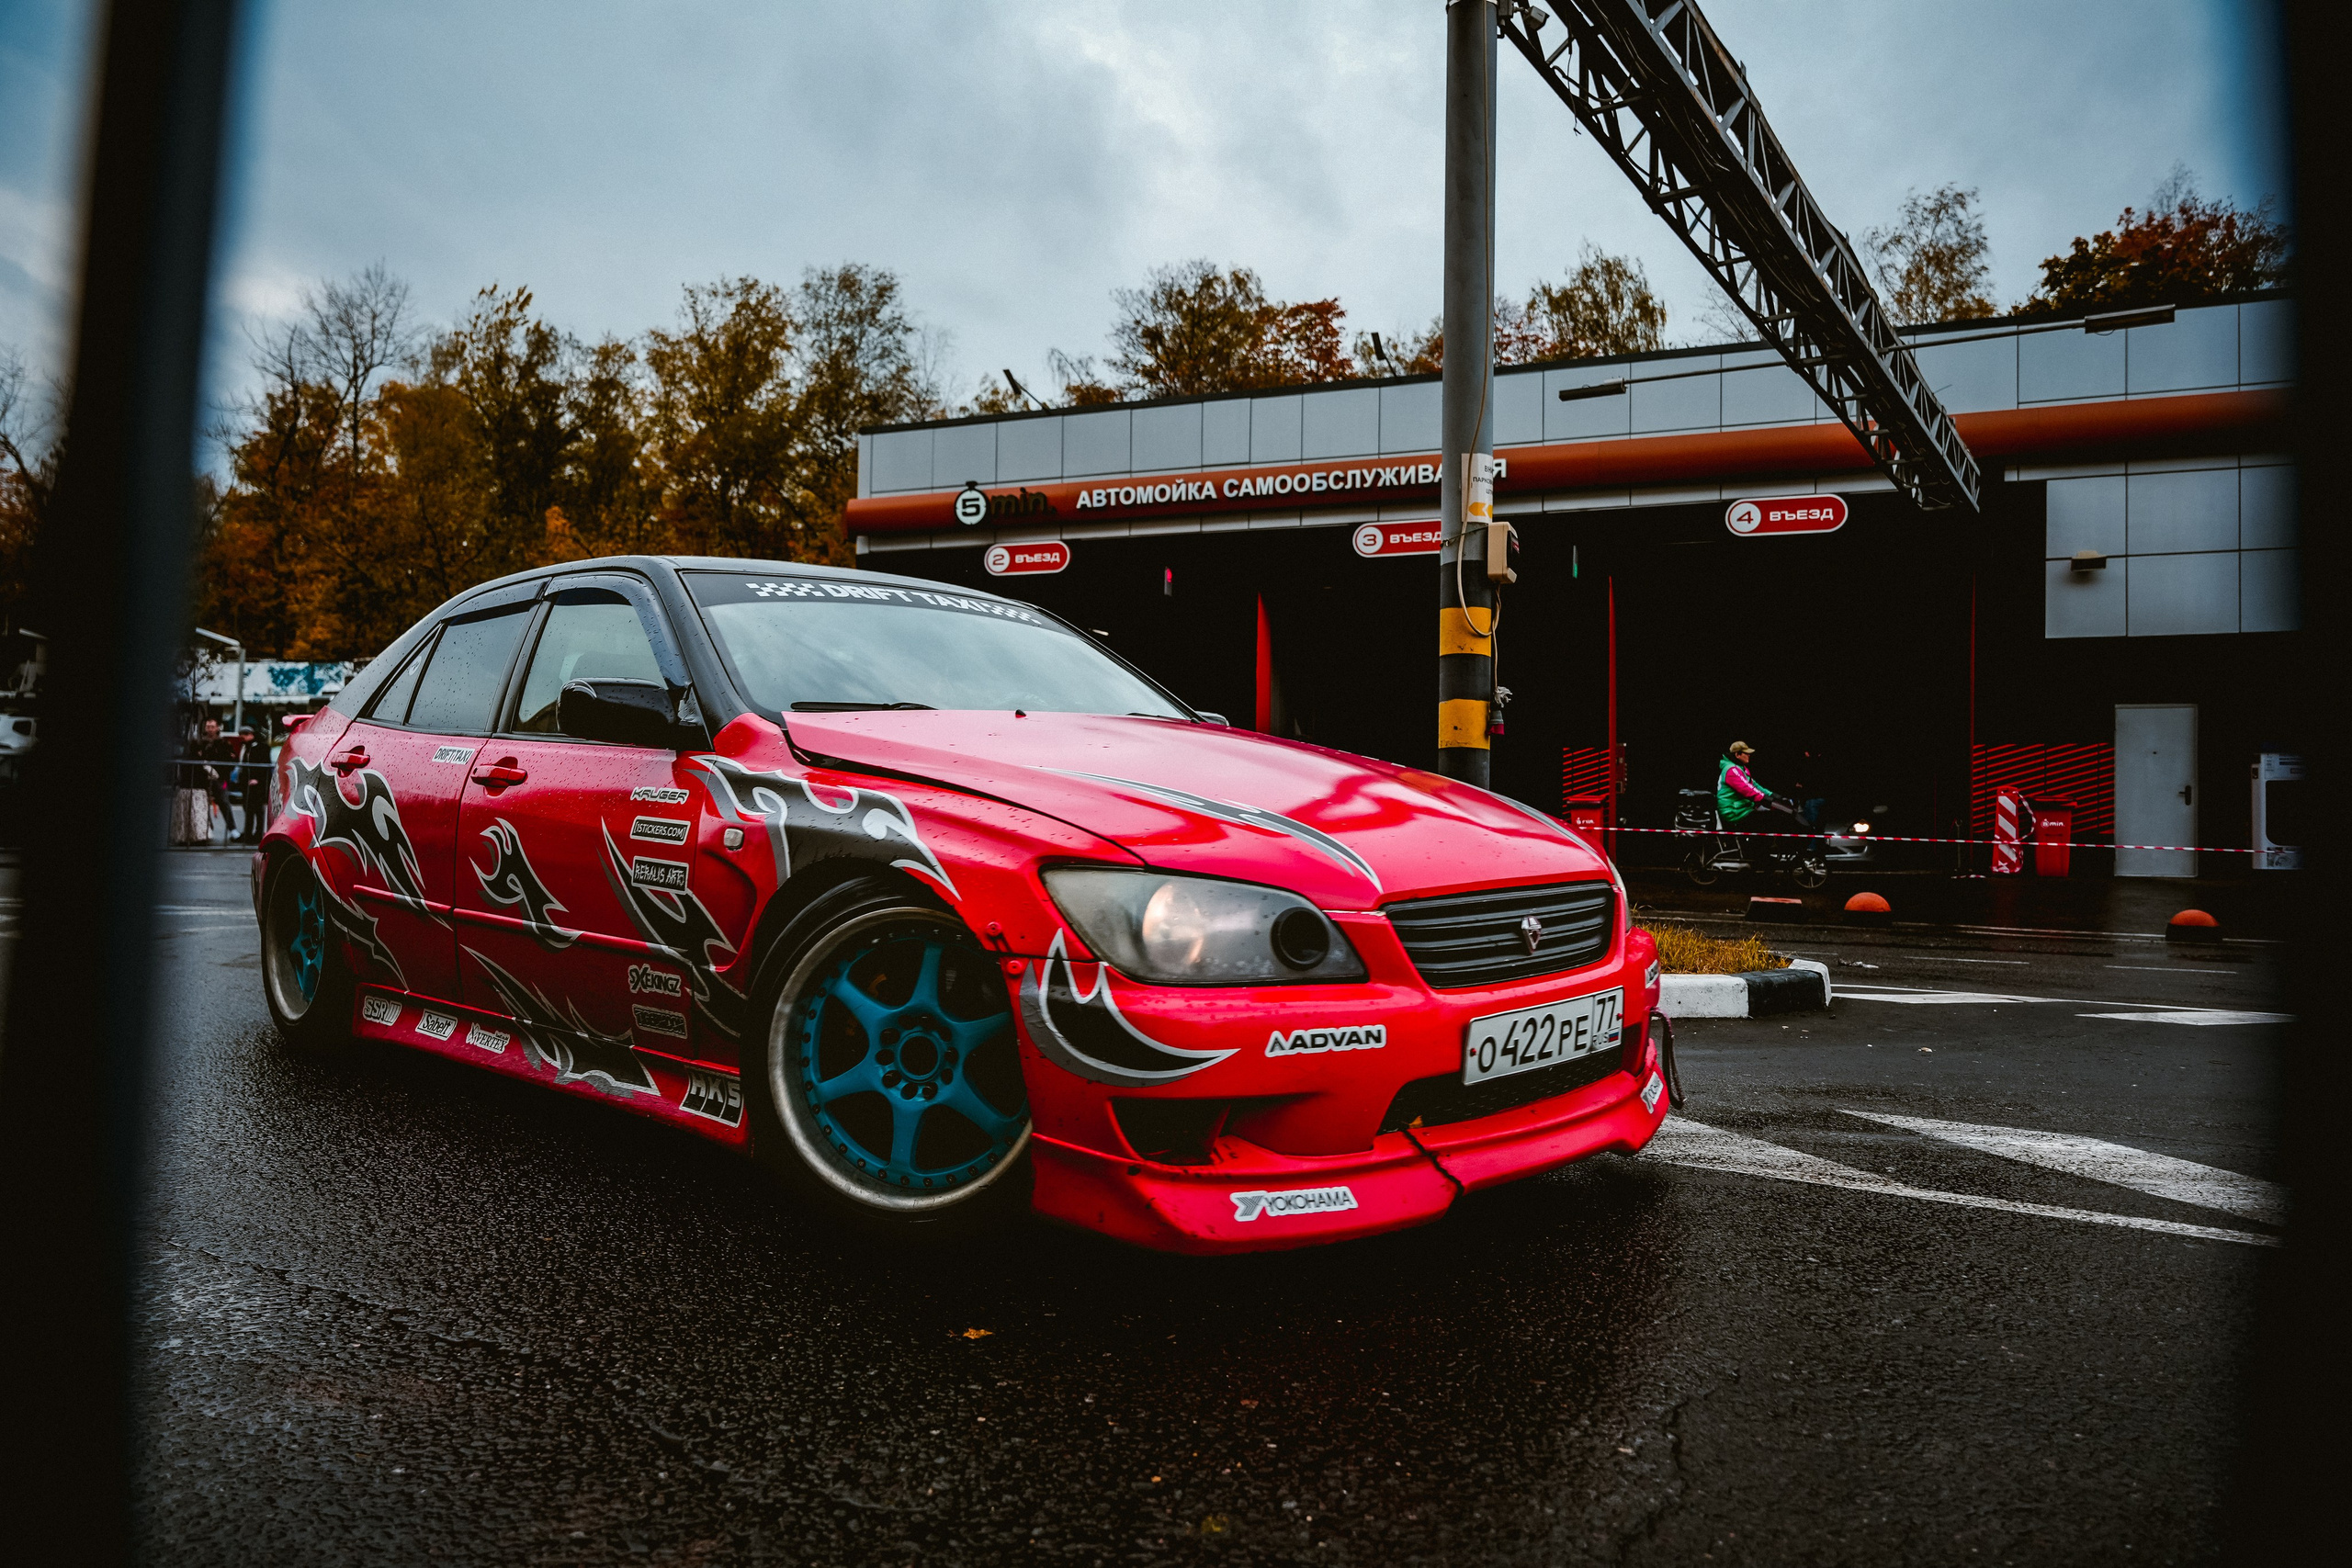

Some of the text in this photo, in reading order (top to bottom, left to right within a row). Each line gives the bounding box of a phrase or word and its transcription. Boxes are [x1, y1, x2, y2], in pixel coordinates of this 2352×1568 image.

[1076, 479, 1217, 509] АВТОМОЙКА
[962, 497, 981, 517] 5
[1736, 508, 1834, 525] 4 ВЪЕЗД
[1363, 531, 1442, 547] 3 ВЪЕЗД
[992, 552, 1061, 566] 2 ВЪЕЗД
[819, 583, 989, 613] DRIFT TAXI
[632, 789, 687, 801] KRUGER
[365, 998, 390, 1021] SSR
[1597, 995, 1617, 1032] 77
[422, 1014, 451, 1035] Sabelt
[1288, 1029, 1382, 1050] ADVAN
[1593, 1032, 1609, 1045] RUS
[690, 1072, 741, 1109] HKS
[1264, 1190, 1353, 1212] YOKOHAMA
